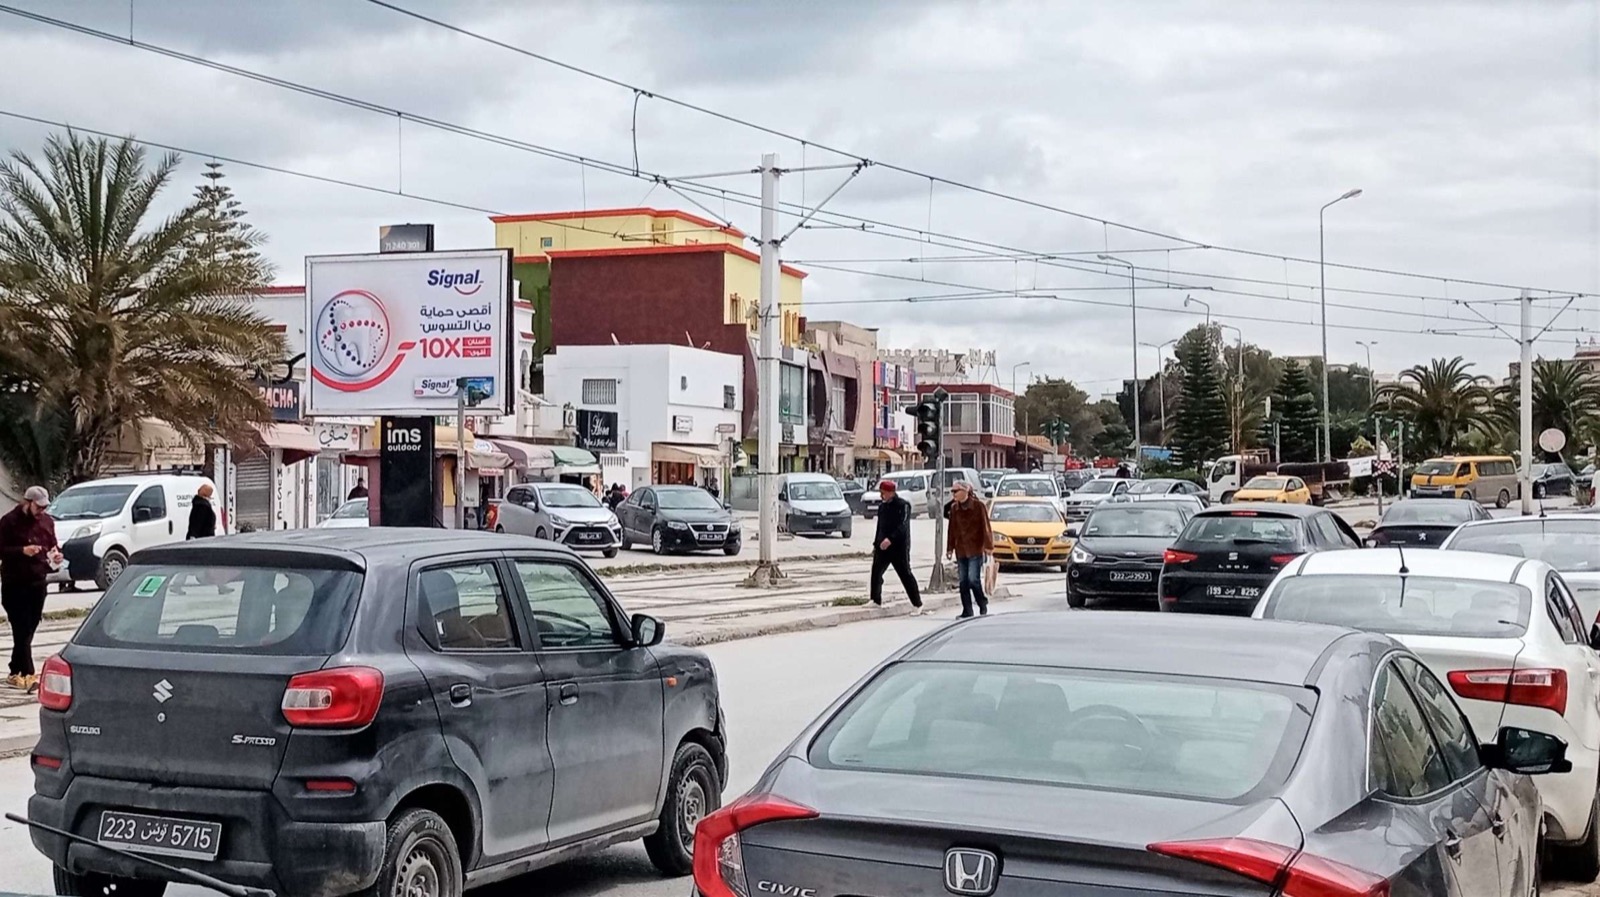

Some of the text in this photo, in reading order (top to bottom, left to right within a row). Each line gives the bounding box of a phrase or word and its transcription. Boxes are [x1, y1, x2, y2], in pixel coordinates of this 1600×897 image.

[427, 269, 480, 288] Signal
[420, 302, 491, 319] أقصى حماية
[473, 320, 491, 332] من
[420, 338, 461, 358] 10X
[421, 379, 450, 391] Signal
[386, 421, 422, 443] ims
[387, 444, 422, 452] outdoor
[70, 725, 101, 735] SUZUKI
[104, 818, 212, 849] 223 تونس 5715
[757, 880, 816, 897] CIVIC
